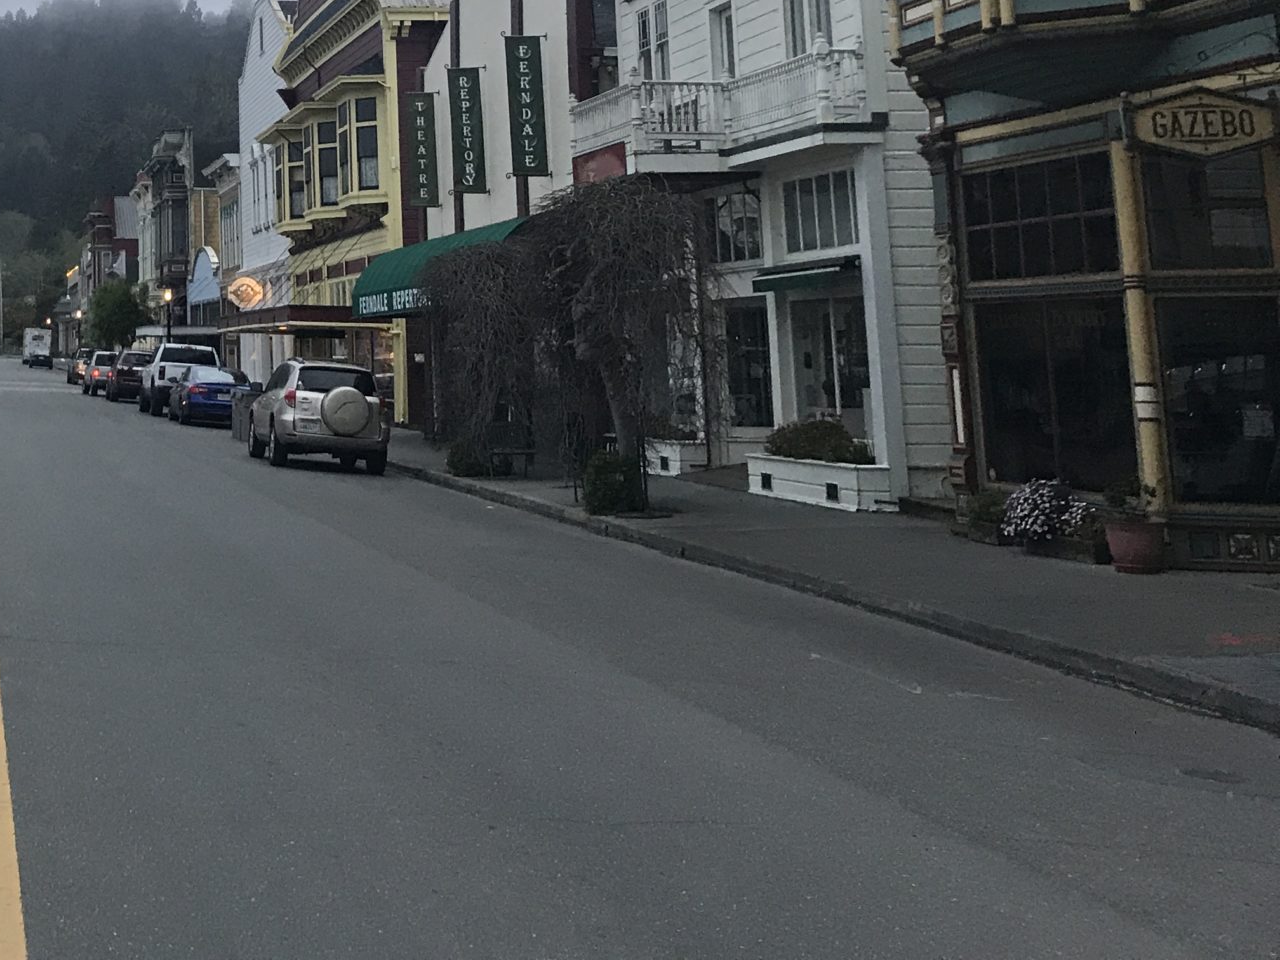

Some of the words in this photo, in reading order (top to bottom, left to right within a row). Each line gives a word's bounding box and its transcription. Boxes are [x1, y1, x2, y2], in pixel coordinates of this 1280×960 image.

[415, 102, 428, 198] THEATRE
[459, 76, 476, 186] REPERTORY
[516, 45, 536, 167] FERNDALE
[1151, 109, 1256, 138] GAZEBO
[359, 292, 388, 314] FERNDALE
